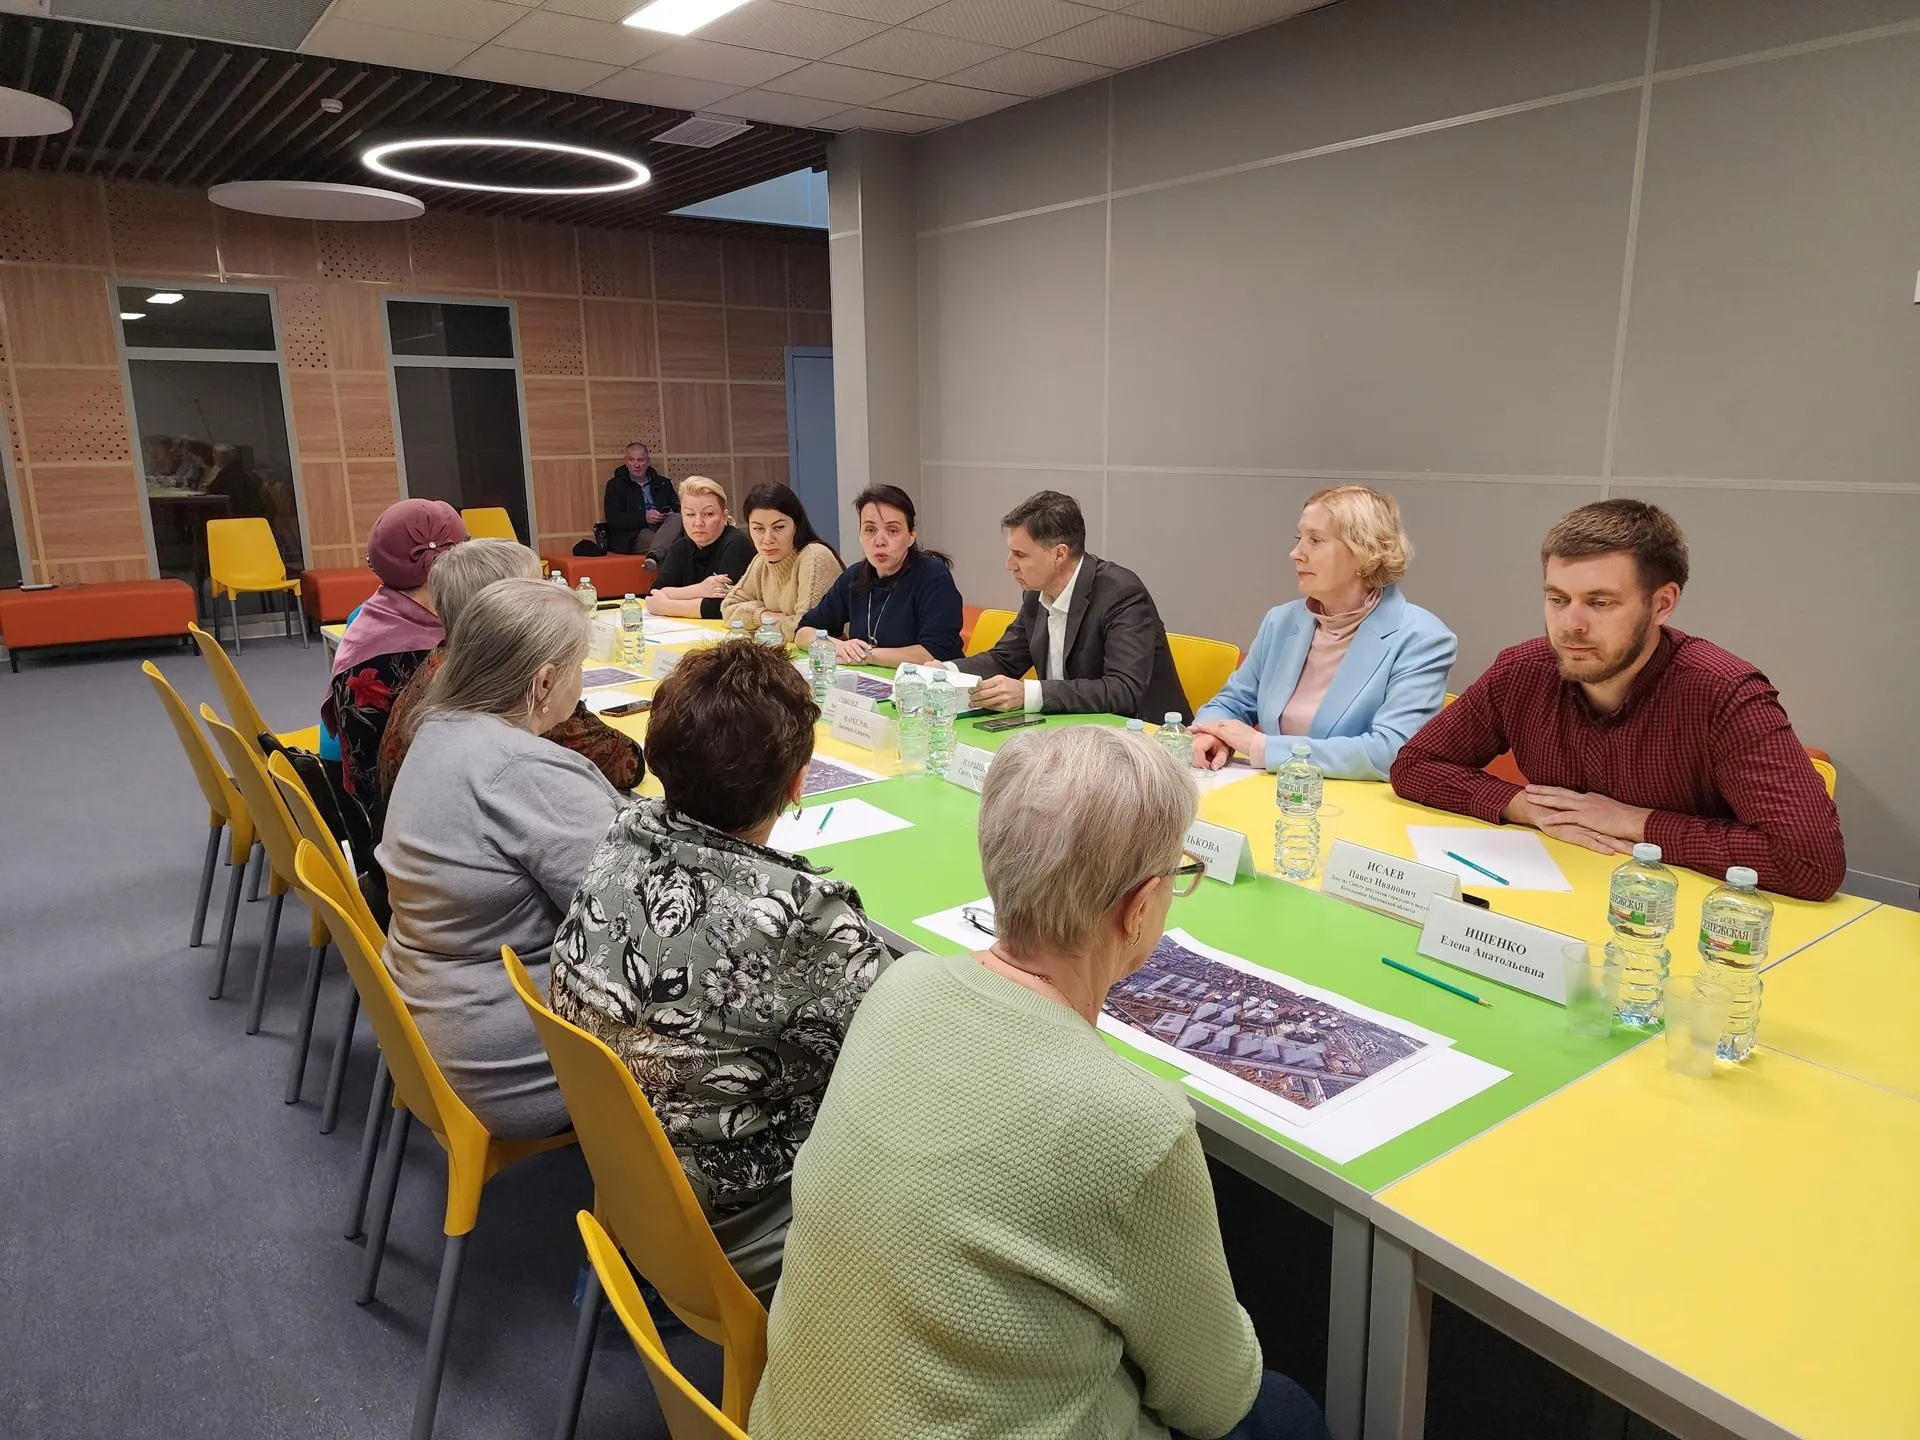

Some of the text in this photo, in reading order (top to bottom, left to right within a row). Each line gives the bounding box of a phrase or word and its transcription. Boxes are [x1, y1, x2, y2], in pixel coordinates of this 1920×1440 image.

[1348, 869, 1417, 898] Павел Иванович
[1367, 861, 1405, 880] ИСАЕВ
[1465, 927, 1527, 955] ИЩЕНКО
[1702, 919, 1749, 940] ЕНЕЖСКАЯ
[1440, 935, 1545, 979] Елена Анатольевна
